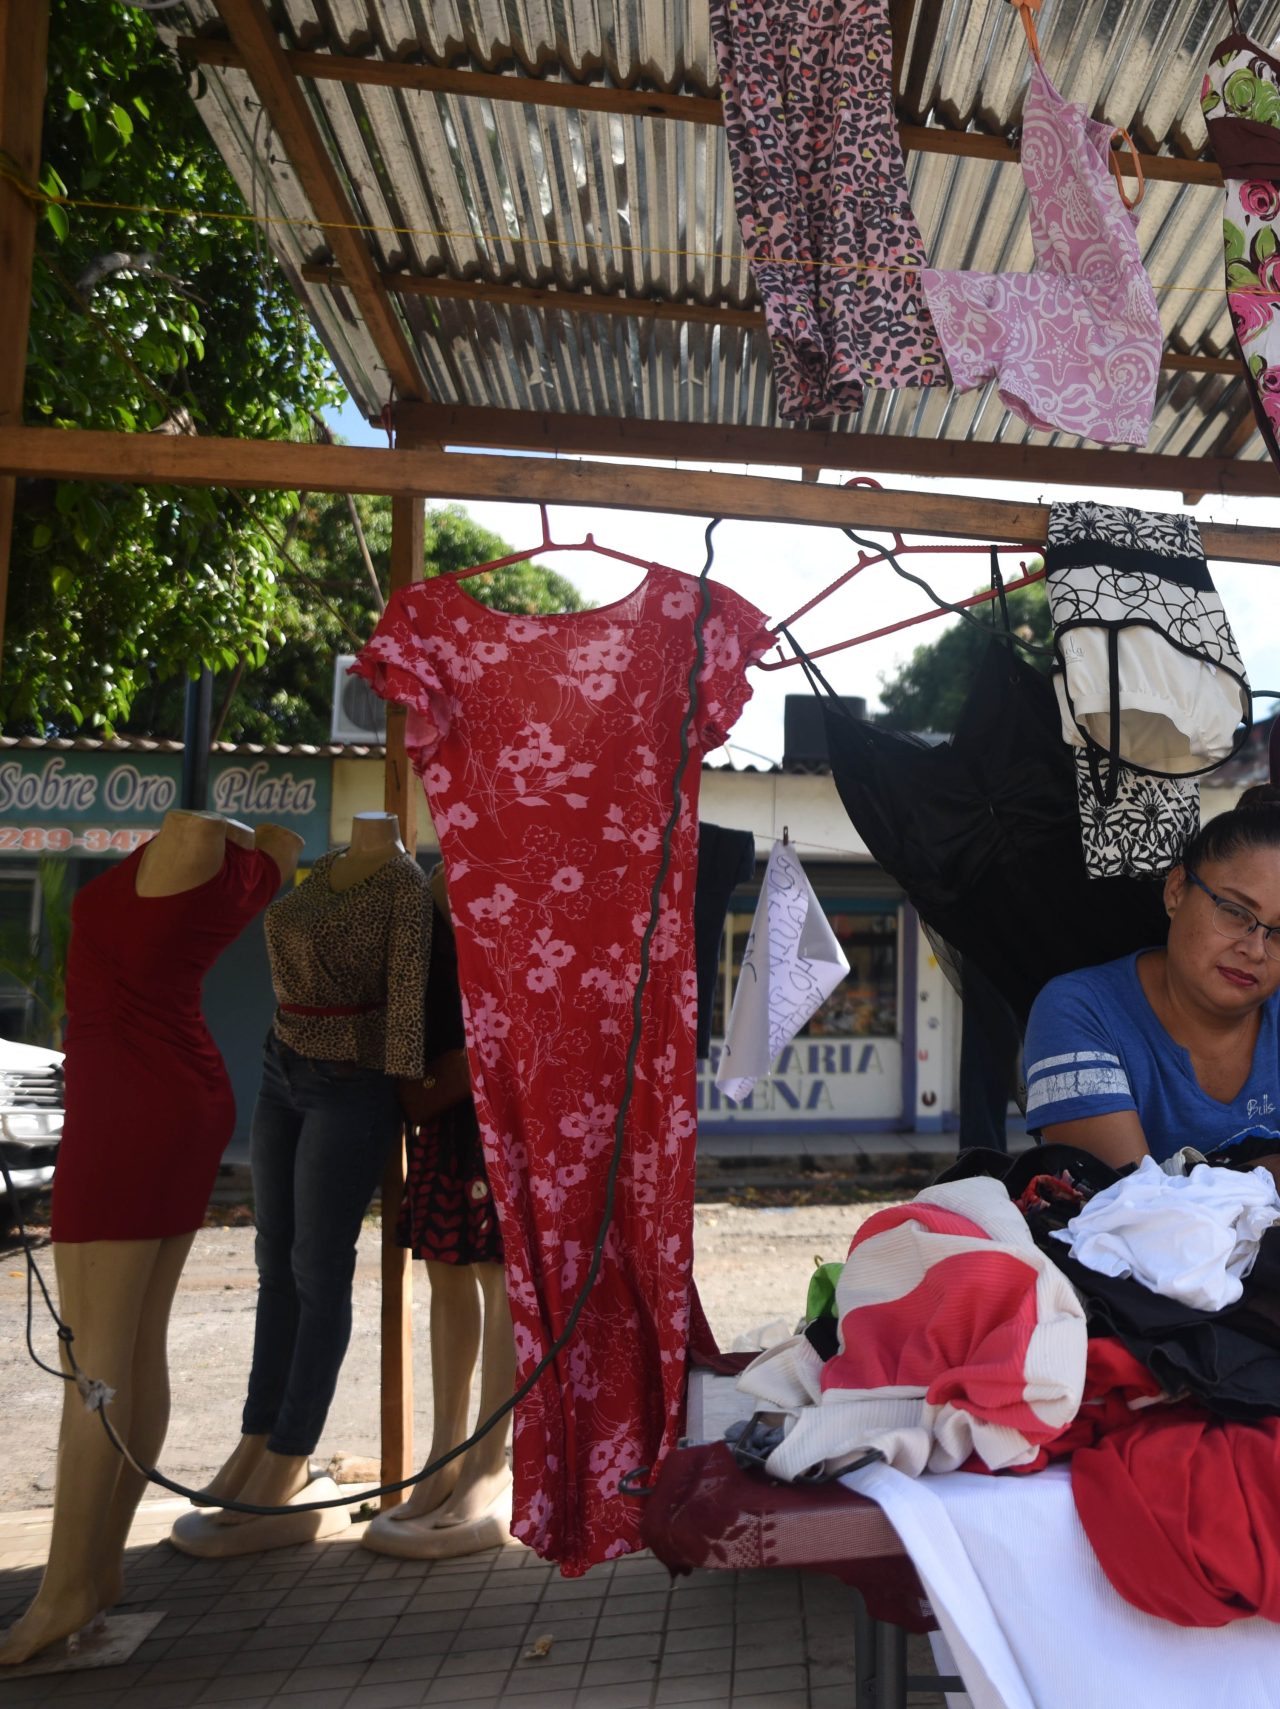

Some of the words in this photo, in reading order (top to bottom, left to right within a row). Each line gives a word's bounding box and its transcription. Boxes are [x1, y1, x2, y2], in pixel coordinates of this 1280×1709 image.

[0, 757, 98, 812] Sobre
[104, 763, 177, 811] Oro
[212, 762, 317, 815] Plata
[0, 826, 160, 851] 289-347
